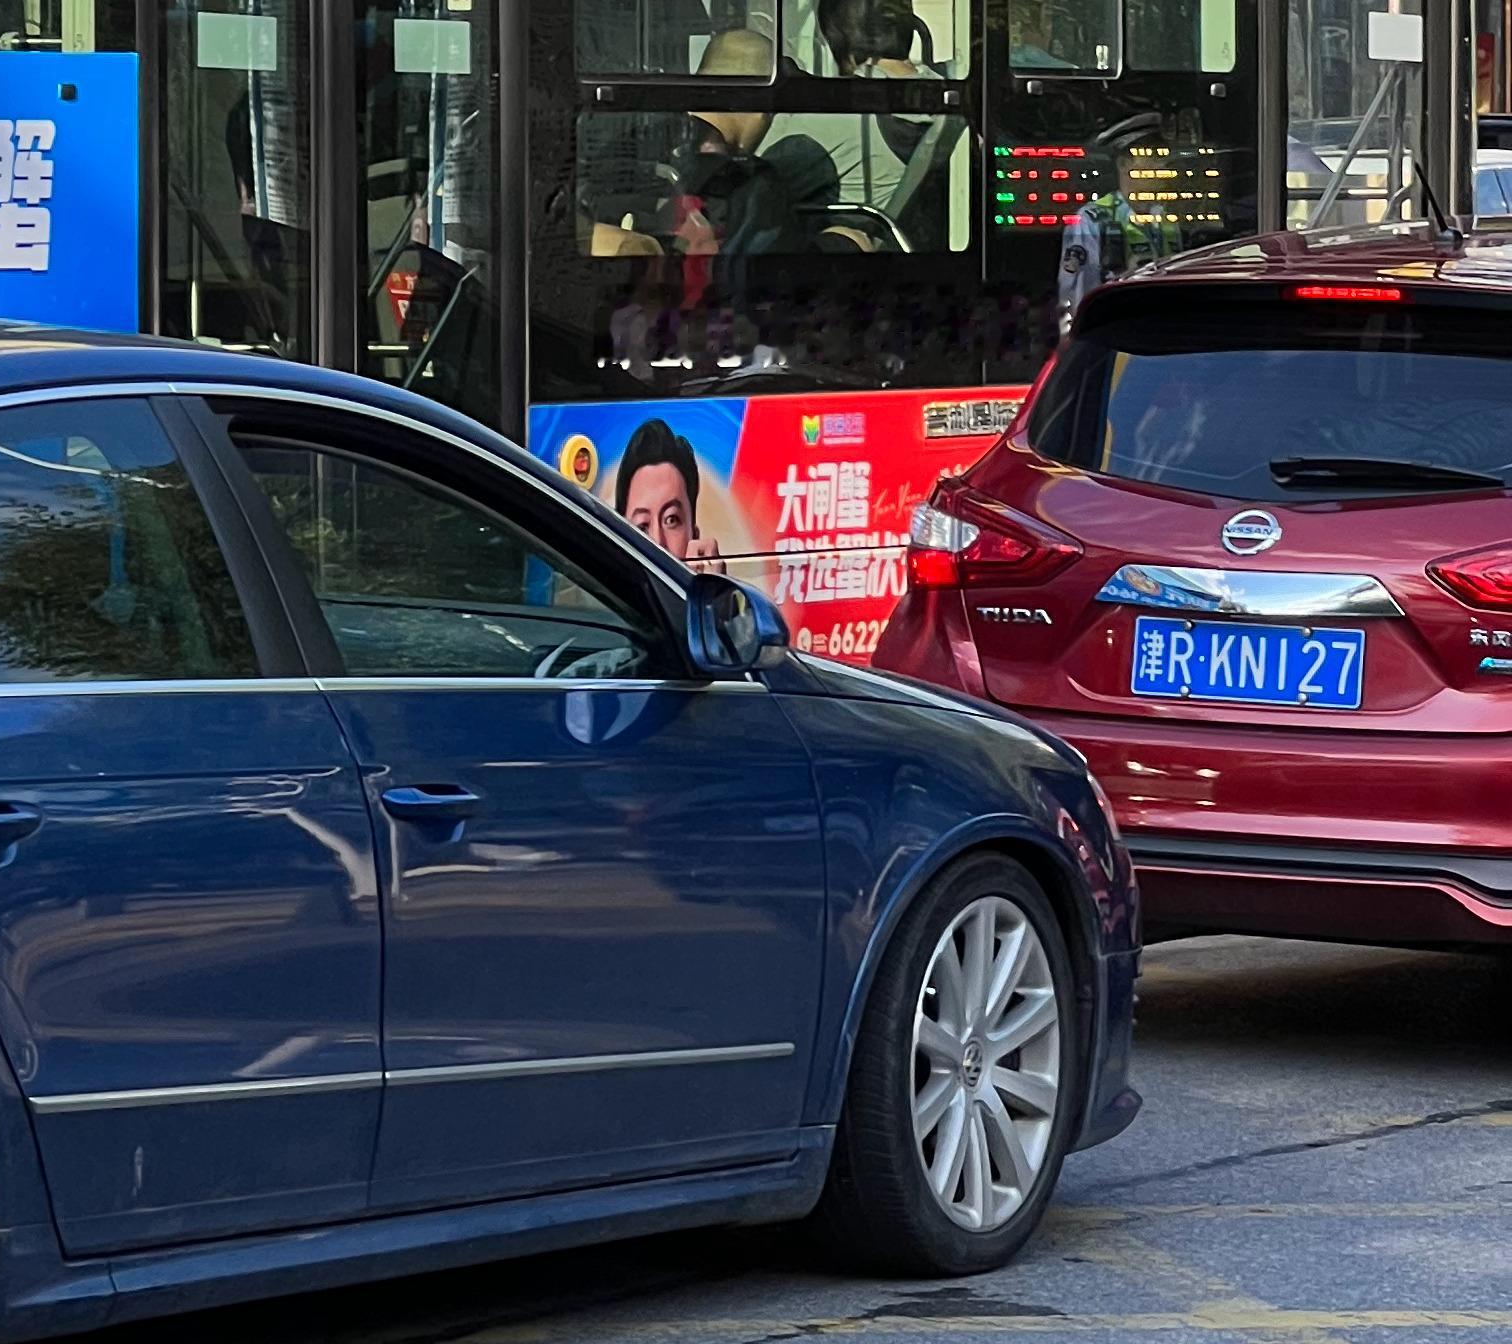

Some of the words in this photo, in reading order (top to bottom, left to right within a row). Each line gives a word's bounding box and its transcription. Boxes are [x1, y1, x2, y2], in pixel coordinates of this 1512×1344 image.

[776, 461, 871, 533] 大闸蟹
[976, 607, 1053, 625] TIIDA
